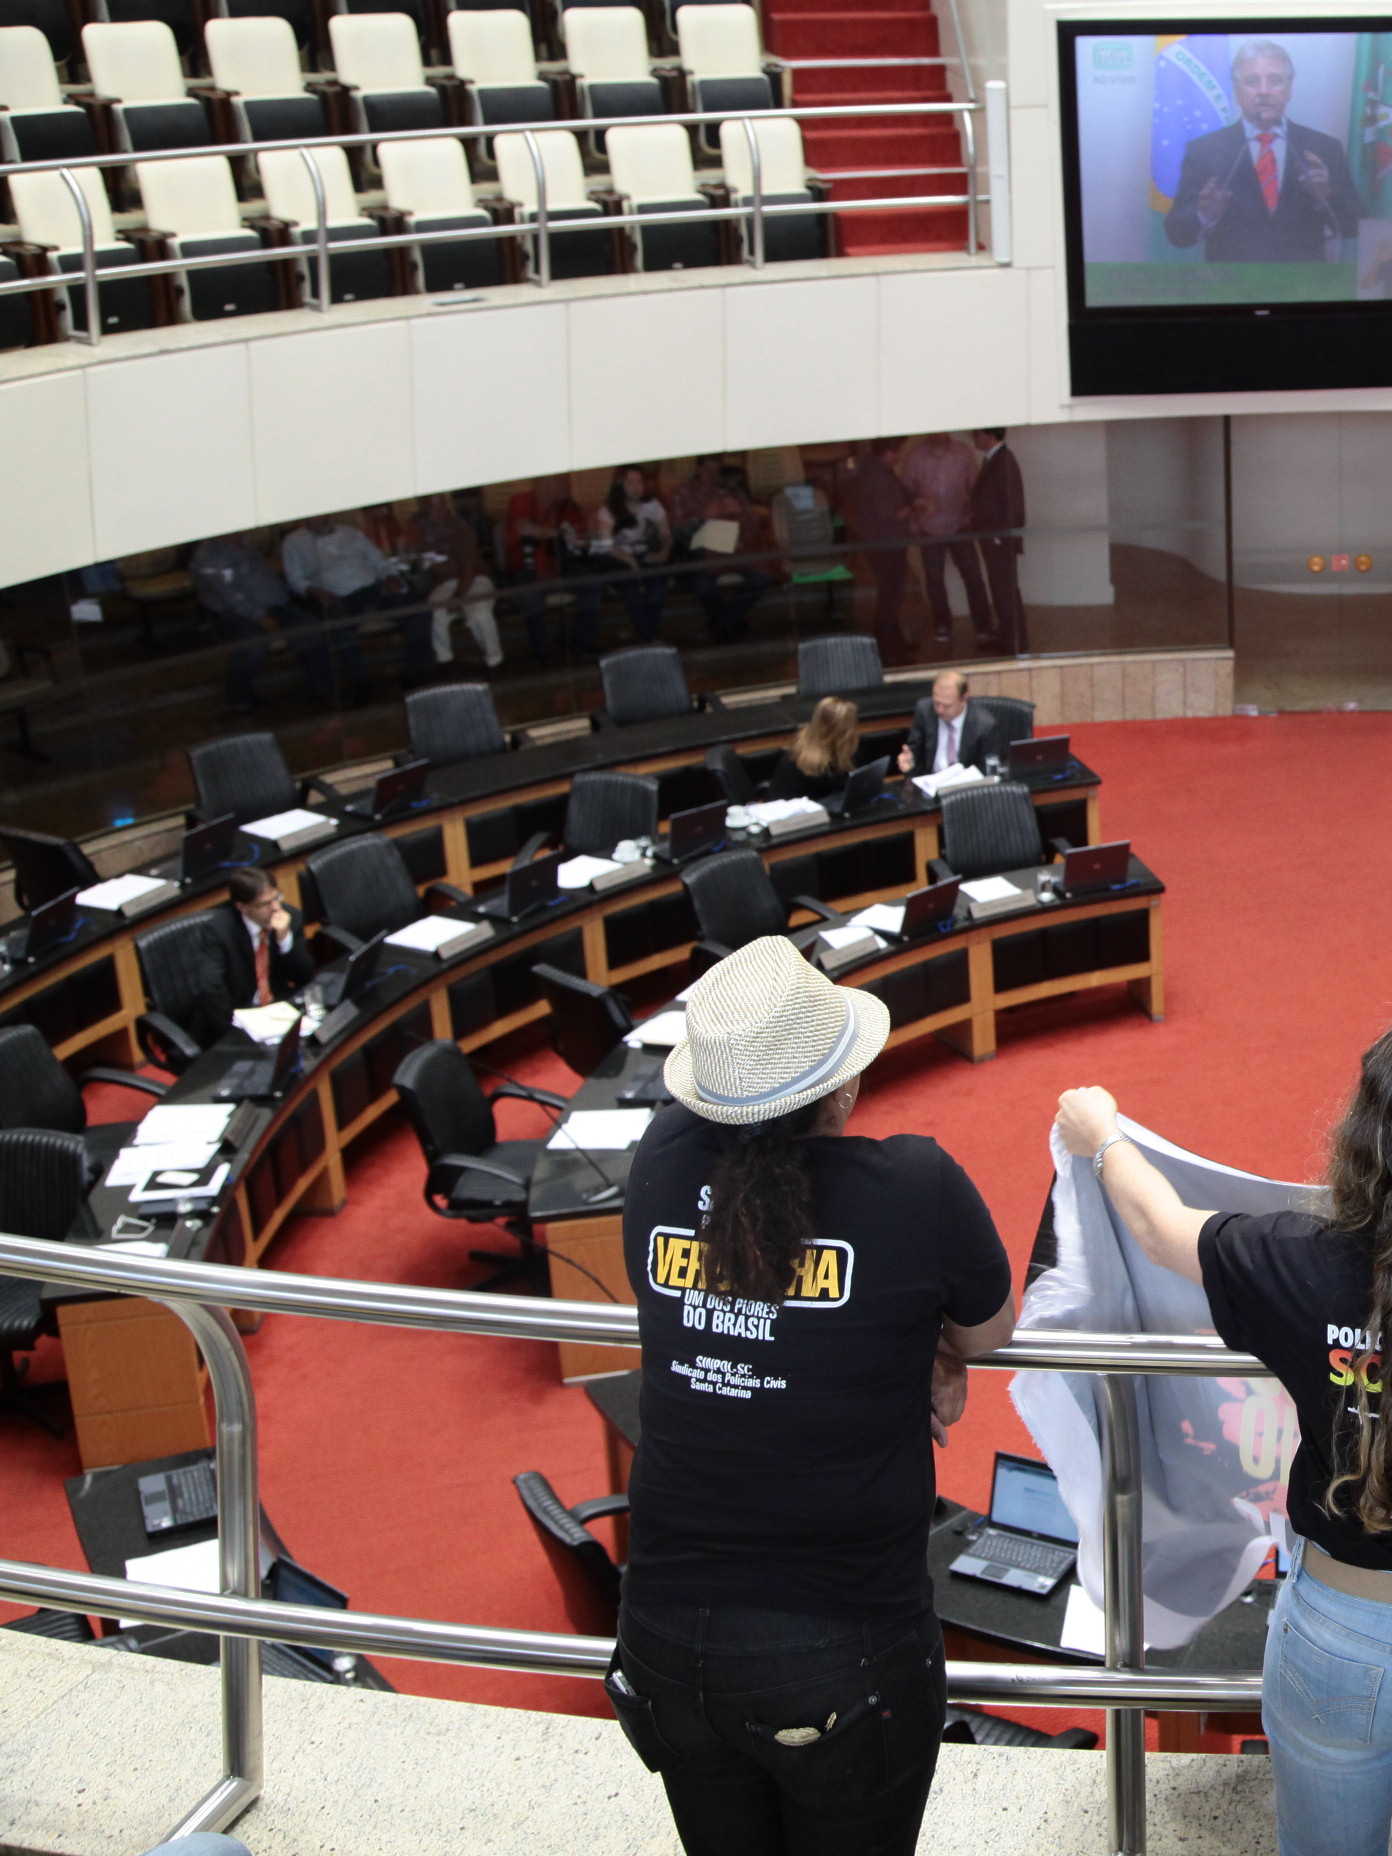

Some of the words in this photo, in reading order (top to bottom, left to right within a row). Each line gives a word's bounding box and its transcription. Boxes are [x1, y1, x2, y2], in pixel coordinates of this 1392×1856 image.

[684, 1289, 705, 1307] UM
[706, 1294, 732, 1311] DOS
[734, 1298, 779, 1319] PIORES
[683, 1305, 706, 1330] DO
[712, 1311, 775, 1341] BRASIL
[670, 1360, 705, 1380] Sindicato
[707, 1370, 722, 1382] dos
[725, 1373, 761, 1388] Policiais
[764, 1377, 787, 1389] Civis
[691, 1378, 714, 1393] Santa
[716, 1384, 752, 1399] Catarina
